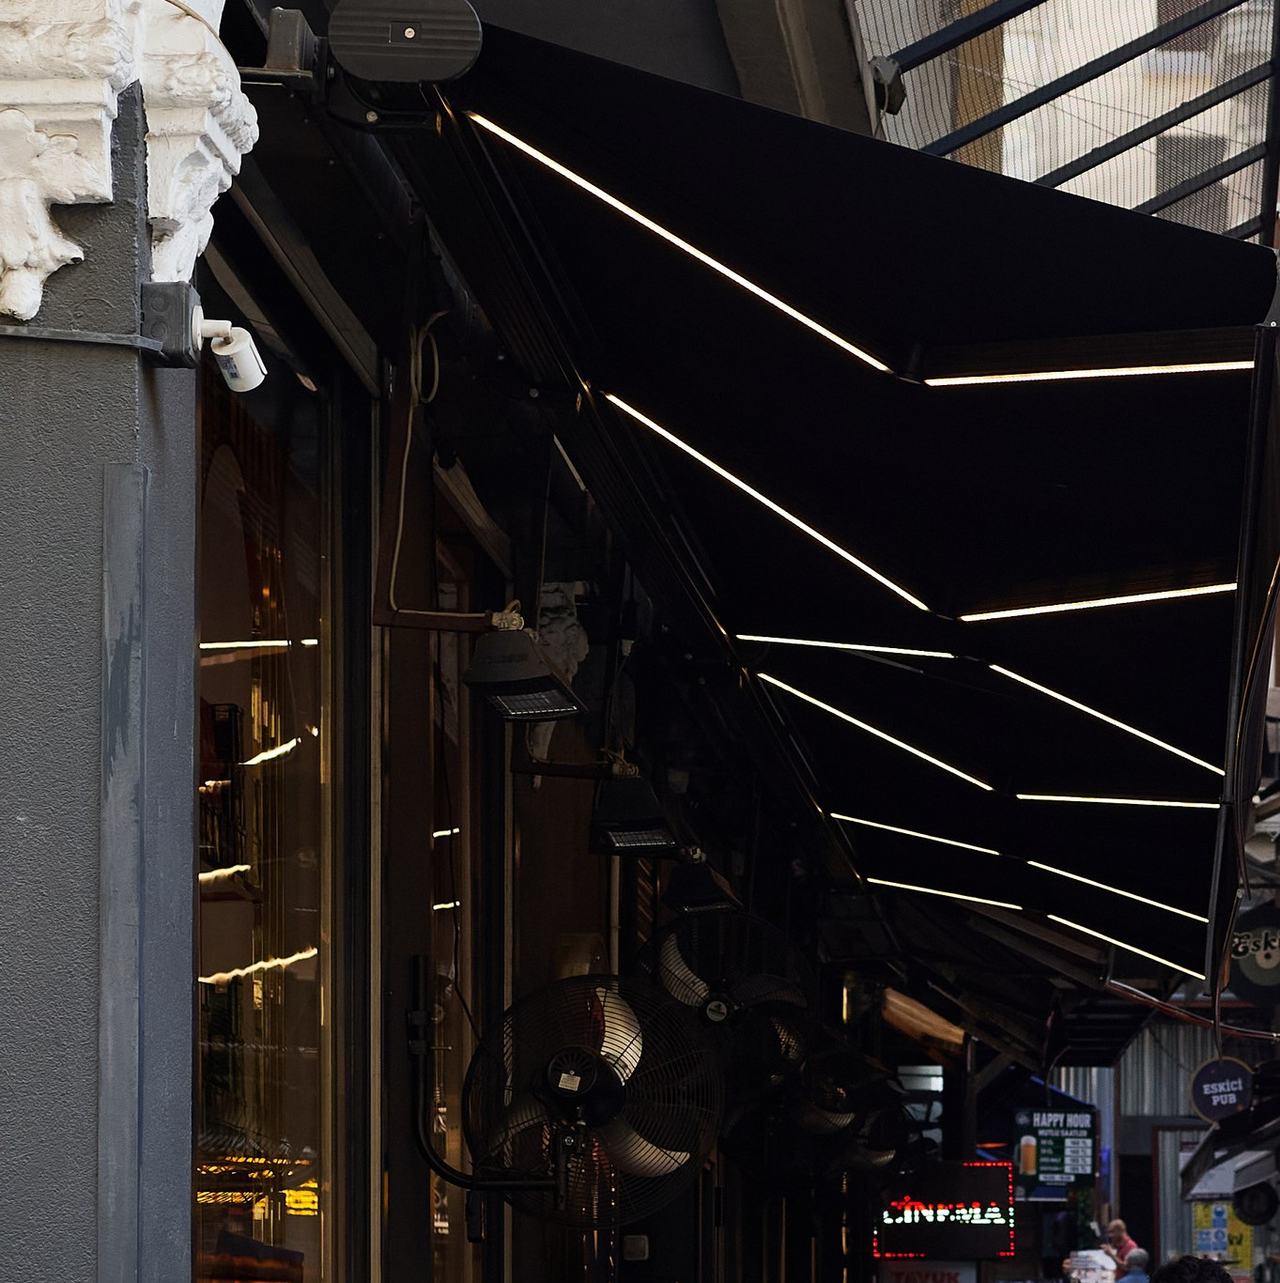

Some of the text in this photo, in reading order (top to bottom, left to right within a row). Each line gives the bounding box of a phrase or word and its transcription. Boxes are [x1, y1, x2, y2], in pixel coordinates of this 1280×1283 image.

[1203, 1077, 1243, 1095] ESKİCİ
[1212, 1093, 1237, 1106] PUB
[1033, 1112, 1091, 1128] HAPPY HOUR
